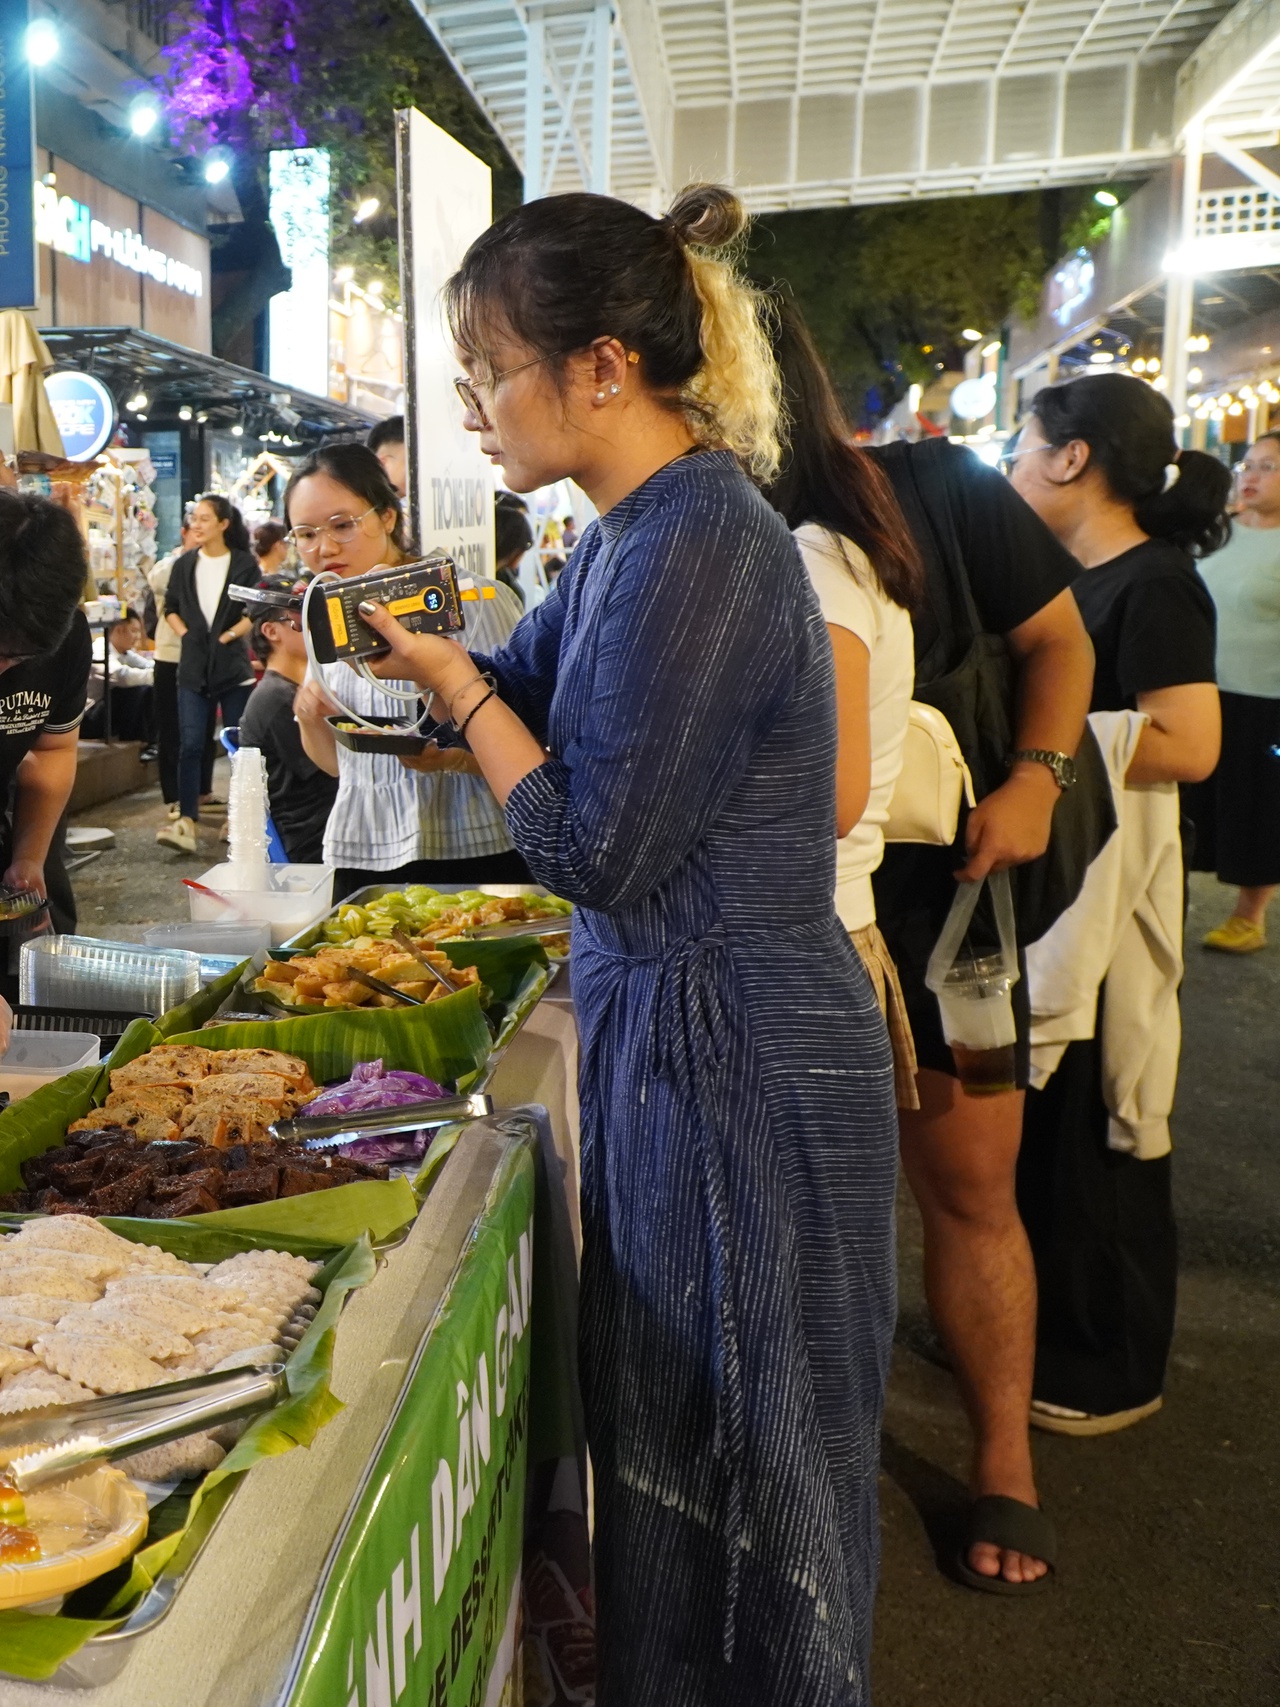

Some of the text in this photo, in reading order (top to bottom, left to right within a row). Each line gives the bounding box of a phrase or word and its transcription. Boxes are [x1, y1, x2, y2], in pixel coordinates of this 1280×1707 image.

[53, 405, 95, 424] OOK
[59, 424, 95, 435] ORE
[431, 1351, 491, 1605] DÂN
[451, 1464, 505, 1684] DESSERT
